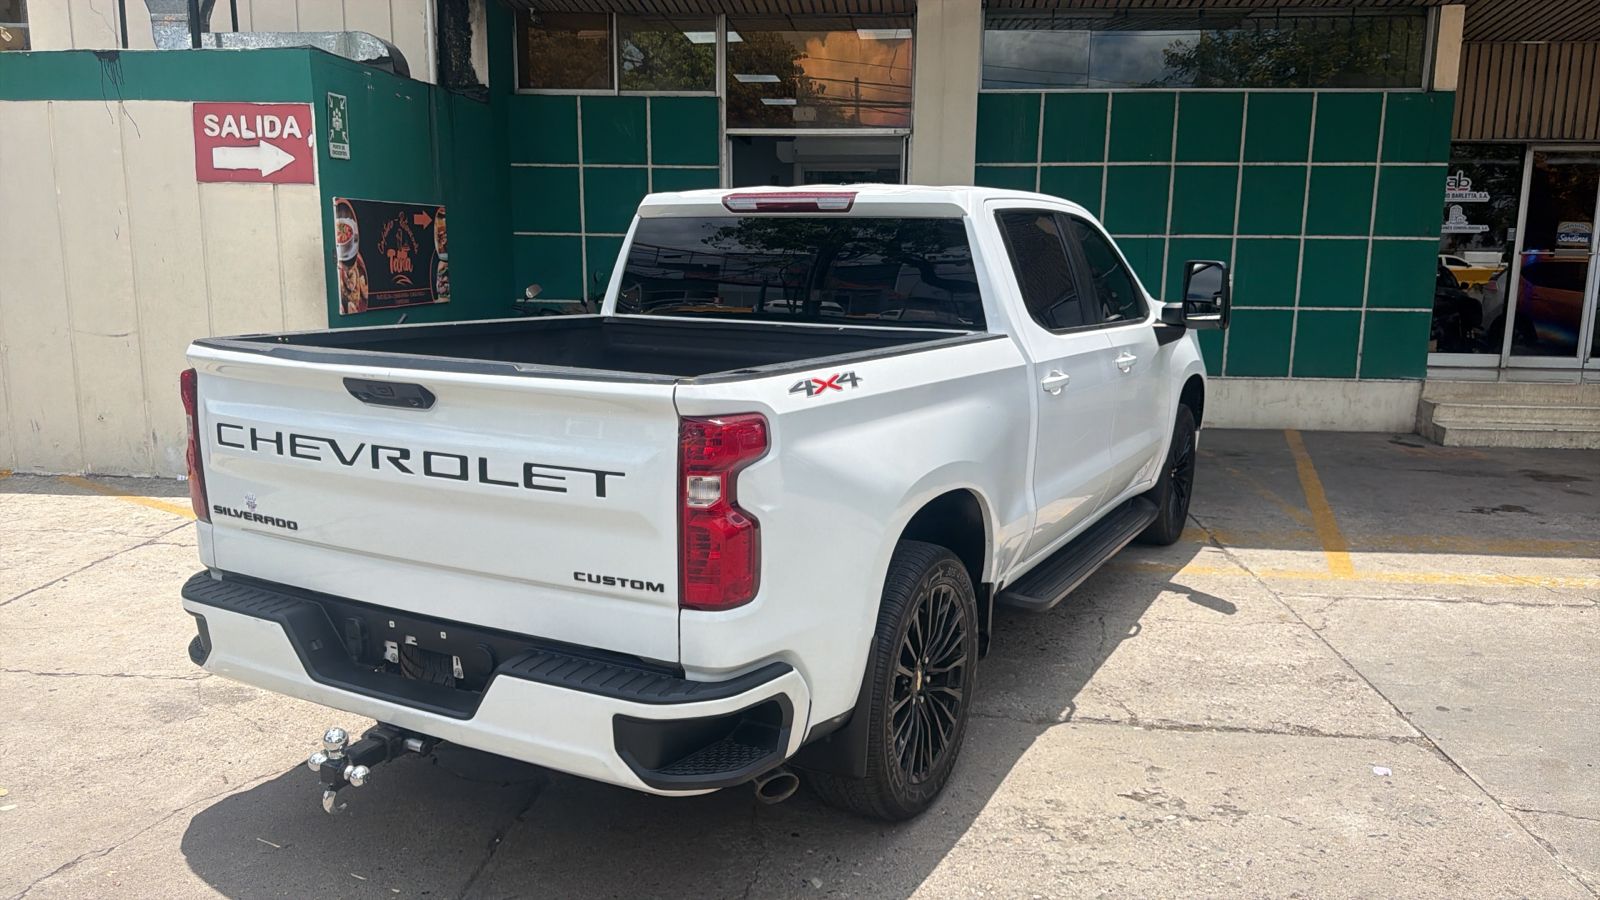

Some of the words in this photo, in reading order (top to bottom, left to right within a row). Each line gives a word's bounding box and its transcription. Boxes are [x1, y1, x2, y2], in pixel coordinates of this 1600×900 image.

[203, 114, 302, 139] SALIDA
[216, 422, 626, 498] CHEVROLET
[213, 504, 298, 531] SILVERADO
[573, 570, 665, 593] CUSTOM
